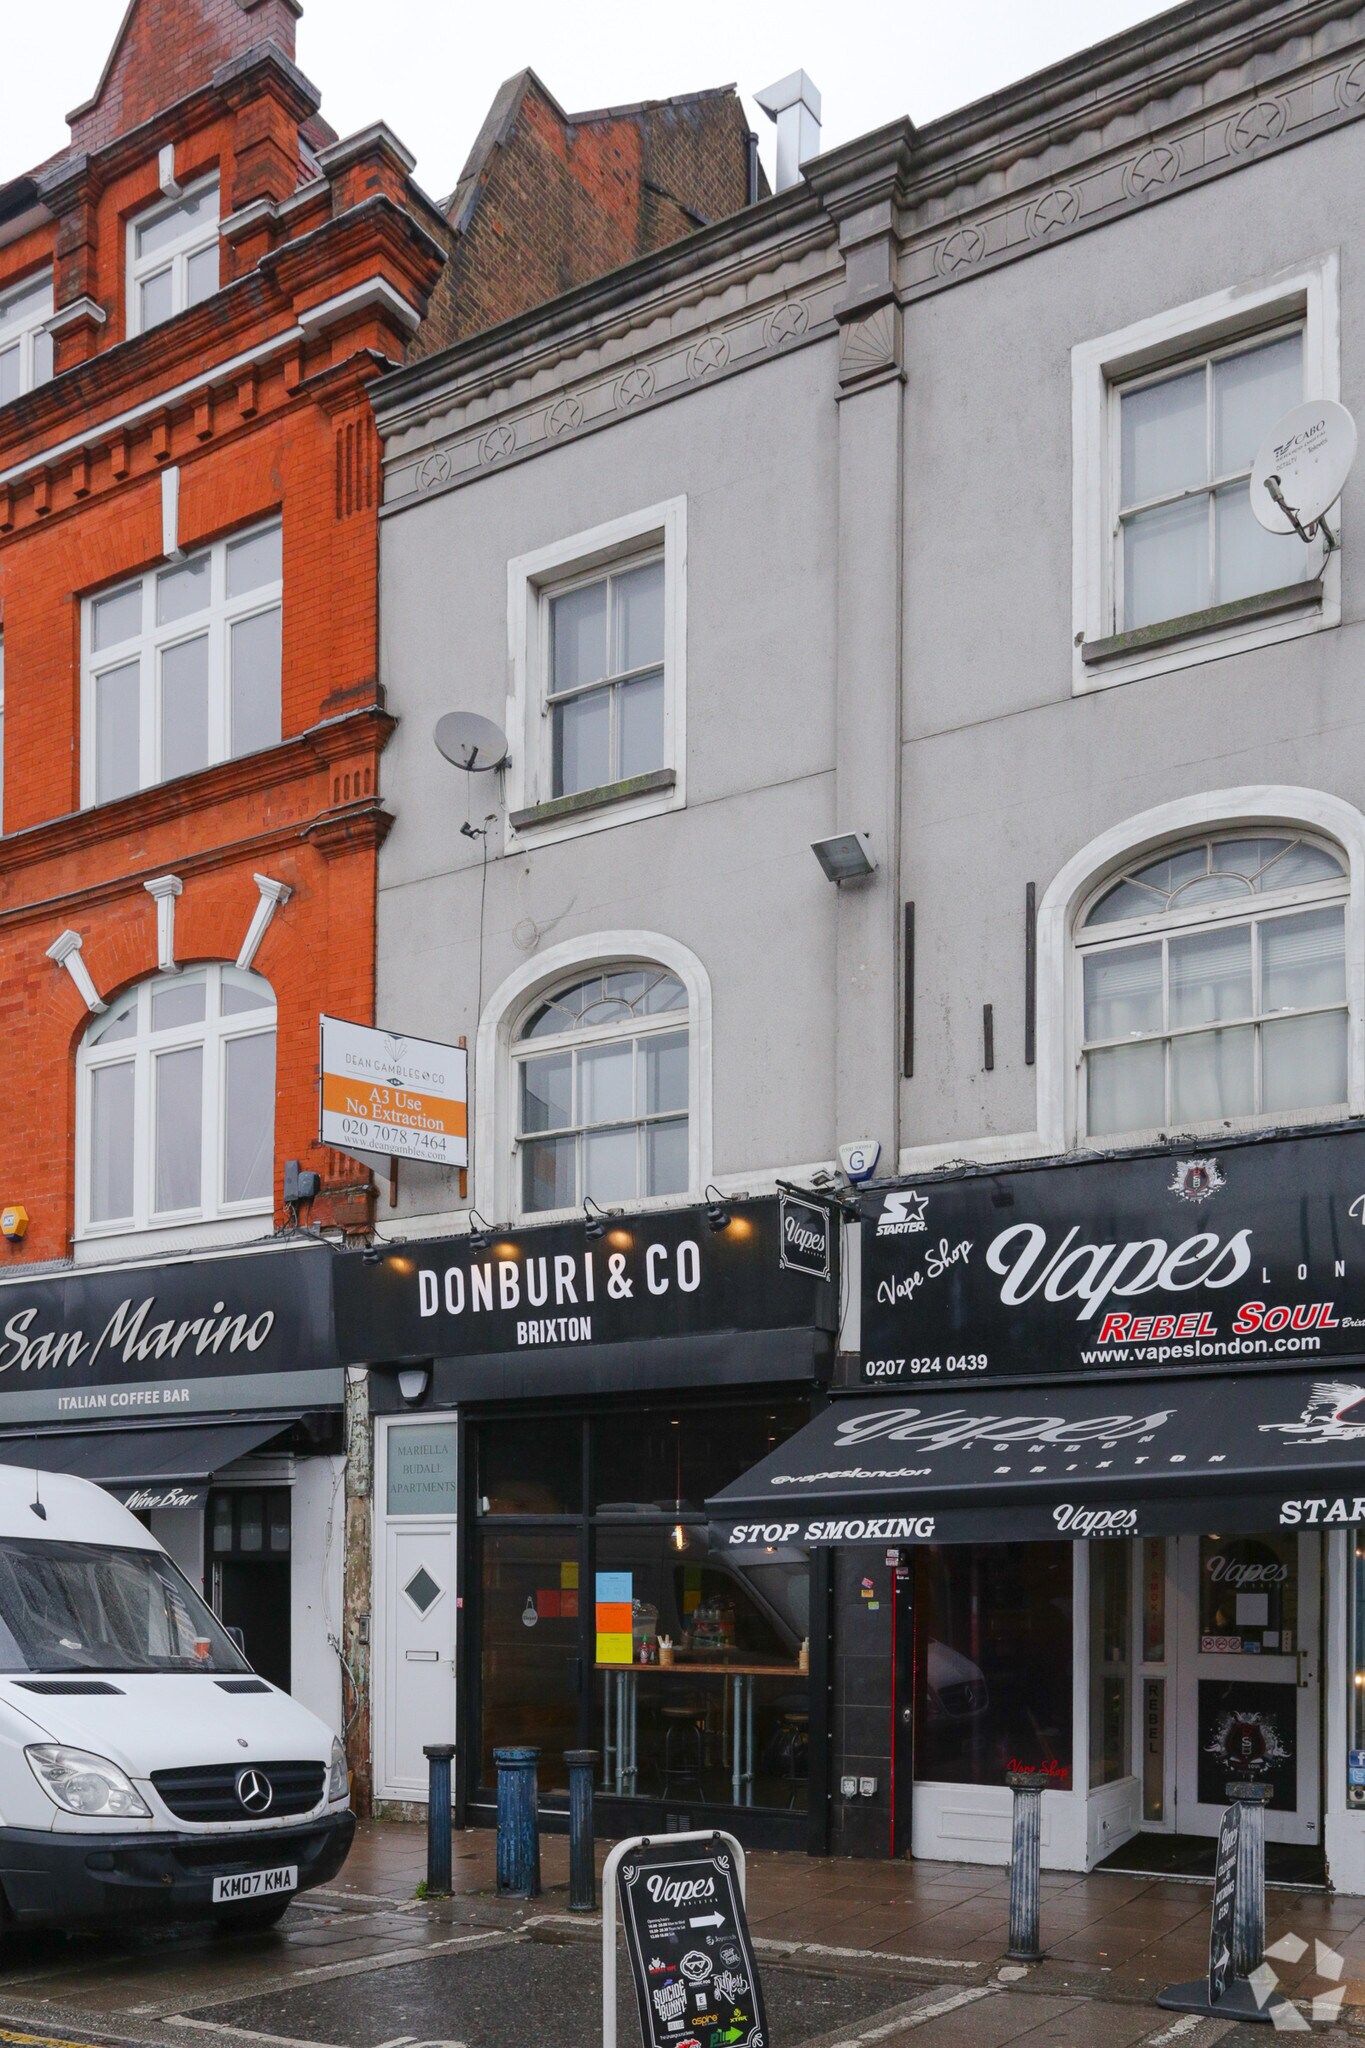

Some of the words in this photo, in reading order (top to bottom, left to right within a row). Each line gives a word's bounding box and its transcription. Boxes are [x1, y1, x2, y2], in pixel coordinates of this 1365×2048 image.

[1294, 420, 1325, 445] CABO
[345, 1053, 371, 1068] DEAN
[373, 1060, 420, 1079] GAMBLES
[346, 1097, 368, 1116] No
[372, 1103, 445, 1131] Extraction
[369, 1087, 389, 1104] A3
[395, 1093, 422, 1112] Use
[342, 1118, 368, 1137] 020
[374, 1125, 407, 1144] 7078
[413, 1132, 447, 1151] 7464
[344, 1135, 446, 1161] www.deangambles.com
[850, 1150, 864, 1171] G
[785, 1216, 825, 1252] Vapes
[418, 1252, 595, 1317] DONBURI
[607, 1253, 634, 1300] &
[646, 1240, 701, 1296] CO
[877, 1271, 924, 1305] Vape
[924, 1238, 973, 1278] Shop
[986, 1223, 1253, 1321] Vapes
[0, 1308, 90, 1372] San
[89, 1297, 275, 1366] Marino
[516, 1316, 592, 1345] BRIXTON
[1097, 1311, 1217, 1345] REBEL
[1232, 1301, 1340, 1335] SOUL
[1081, 1335, 1321, 1365] www.vapeslondon.com
[865, 1360, 906, 1377] 0207
[910, 1357, 942, 1374] 924
[946, 1354, 988, 1372] 0439
[58, 1395, 107, 1410] ITALIAN
[110, 1391, 160, 1407] COFFEE
[163, 1388, 190, 1404] BAR
[834, 1409, 1178, 1453] Vapes
[961, 1434, 1155, 1453] LONDON
[397, 1444, 449, 1457] MARIELLA
[993, 1454, 1226, 1474] BRIXTON
[390, 1481, 456, 1494] APARTMENTS
[771, 1467, 932, 1485] @vapeslondon
[124, 1488, 161, 1509] Wine
[157, 1488, 198, 1507] Bar
[728, 1522, 800, 1545] STOP
[803, 1516, 936, 1542] SMOKING
[1052, 1503, 1138, 1537] Vapes
[1092, 1528, 1138, 1537] LONDON
[1206, 1555, 1289, 1588] Vapes
[220, 1875, 261, 1898] KM07
[265, 1869, 291, 1891] KMA
[646, 1874, 715, 1908] Vapes
[653, 1979, 685, 2009] SUICIDE
